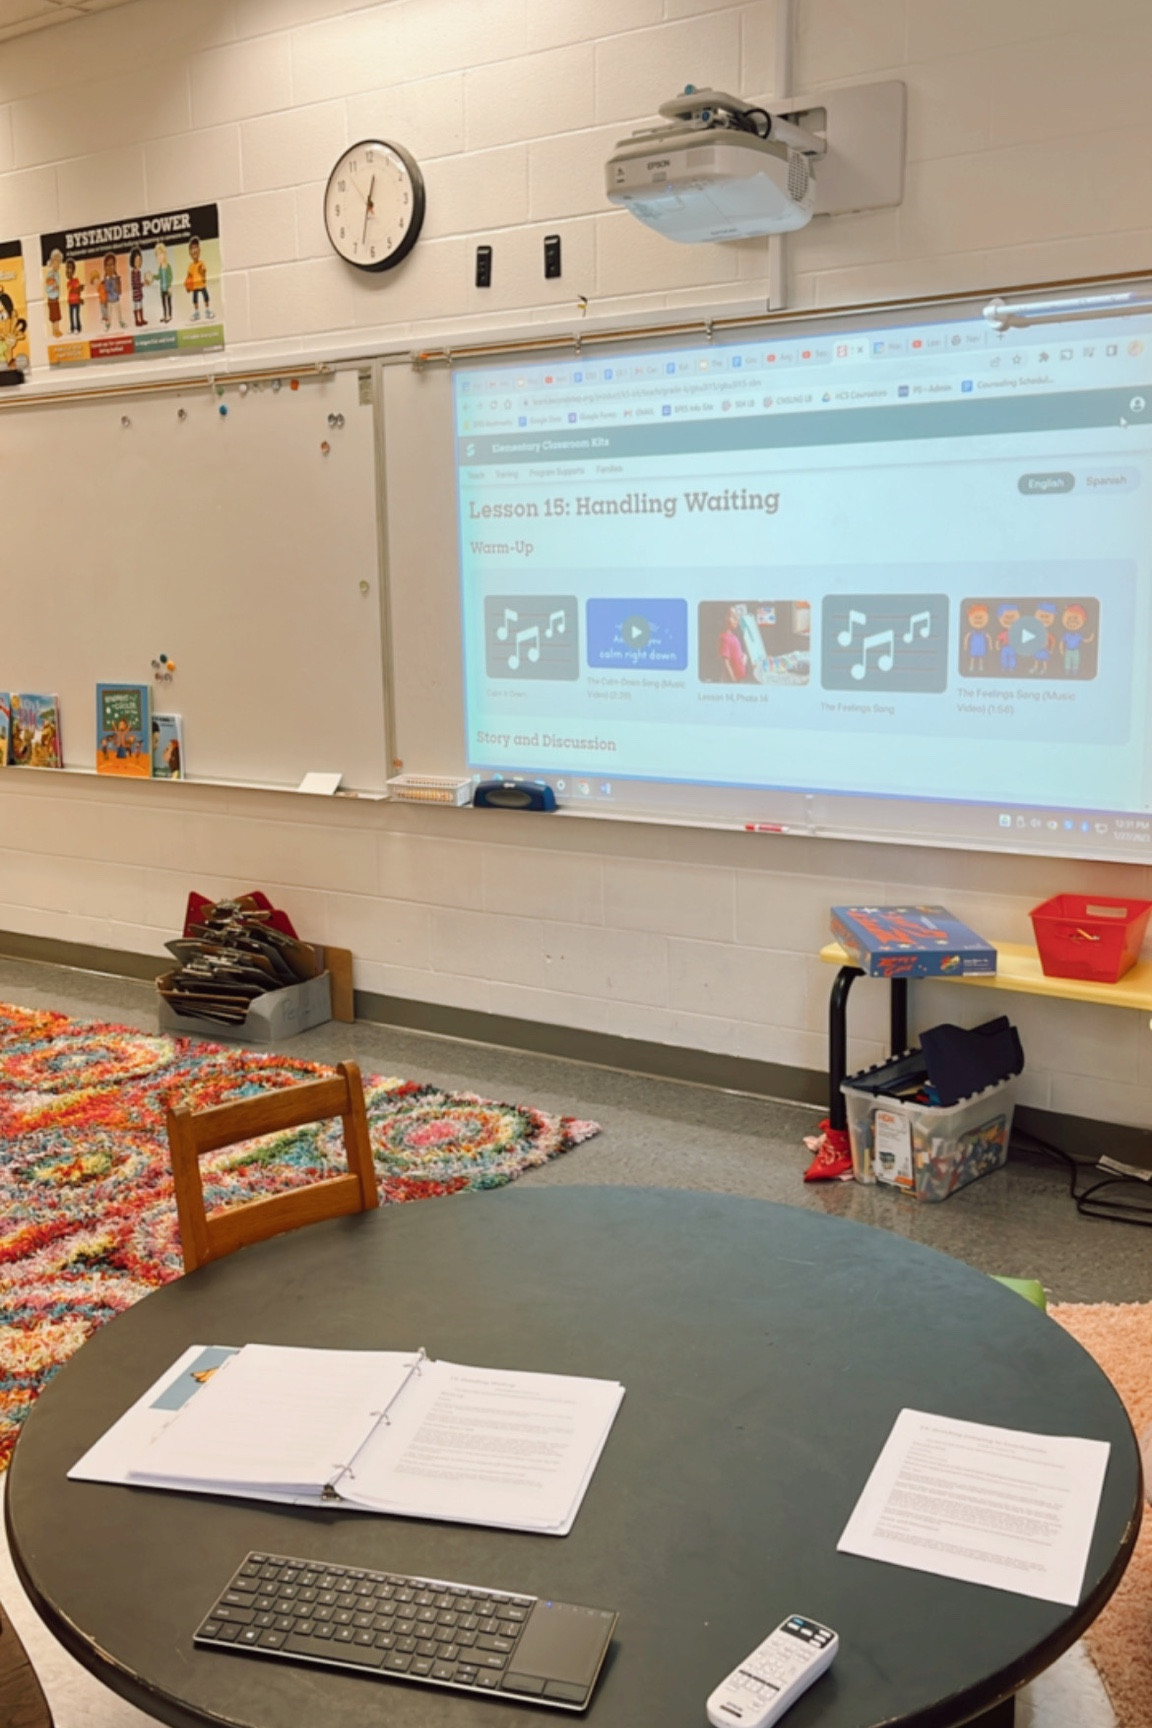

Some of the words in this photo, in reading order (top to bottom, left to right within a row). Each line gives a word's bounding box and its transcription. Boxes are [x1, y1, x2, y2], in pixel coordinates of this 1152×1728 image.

[365, 150, 374, 164] 12
[348, 160, 358, 173] 11
[647, 159, 671, 170] EPSON
[65, 224, 140, 249] BYSTANDER
[142, 213, 192, 236] POWER
[492, 441, 541, 453] Elementary
[542, 439, 589, 451] Classroom
[591, 437, 610, 447] Kits
[1028, 477, 1065, 489] English
[1086, 475, 1127, 487] Spanish
[469, 500, 539, 519] Lesson
[544, 497, 571, 517] 15:
[576, 493, 678, 518] Handling
[684, 488, 781, 514] Waiting
[470, 540, 534, 557] Warm-Up
[599, 648, 622, 659] calm
[625, 648, 647, 664] right
[649, 649, 677, 660] down
[957, 688, 975, 697] The
[976, 689, 1014, 700] Feelings
[1016, 690, 1040, 701] Song
[820, 702, 836, 711] The
[837, 703, 872, 714] Feelings
[873, 704, 895, 715] Song
[477, 730, 511, 748] Story
[514, 732, 539, 747] and
[542, 733, 617, 752] Discussion
